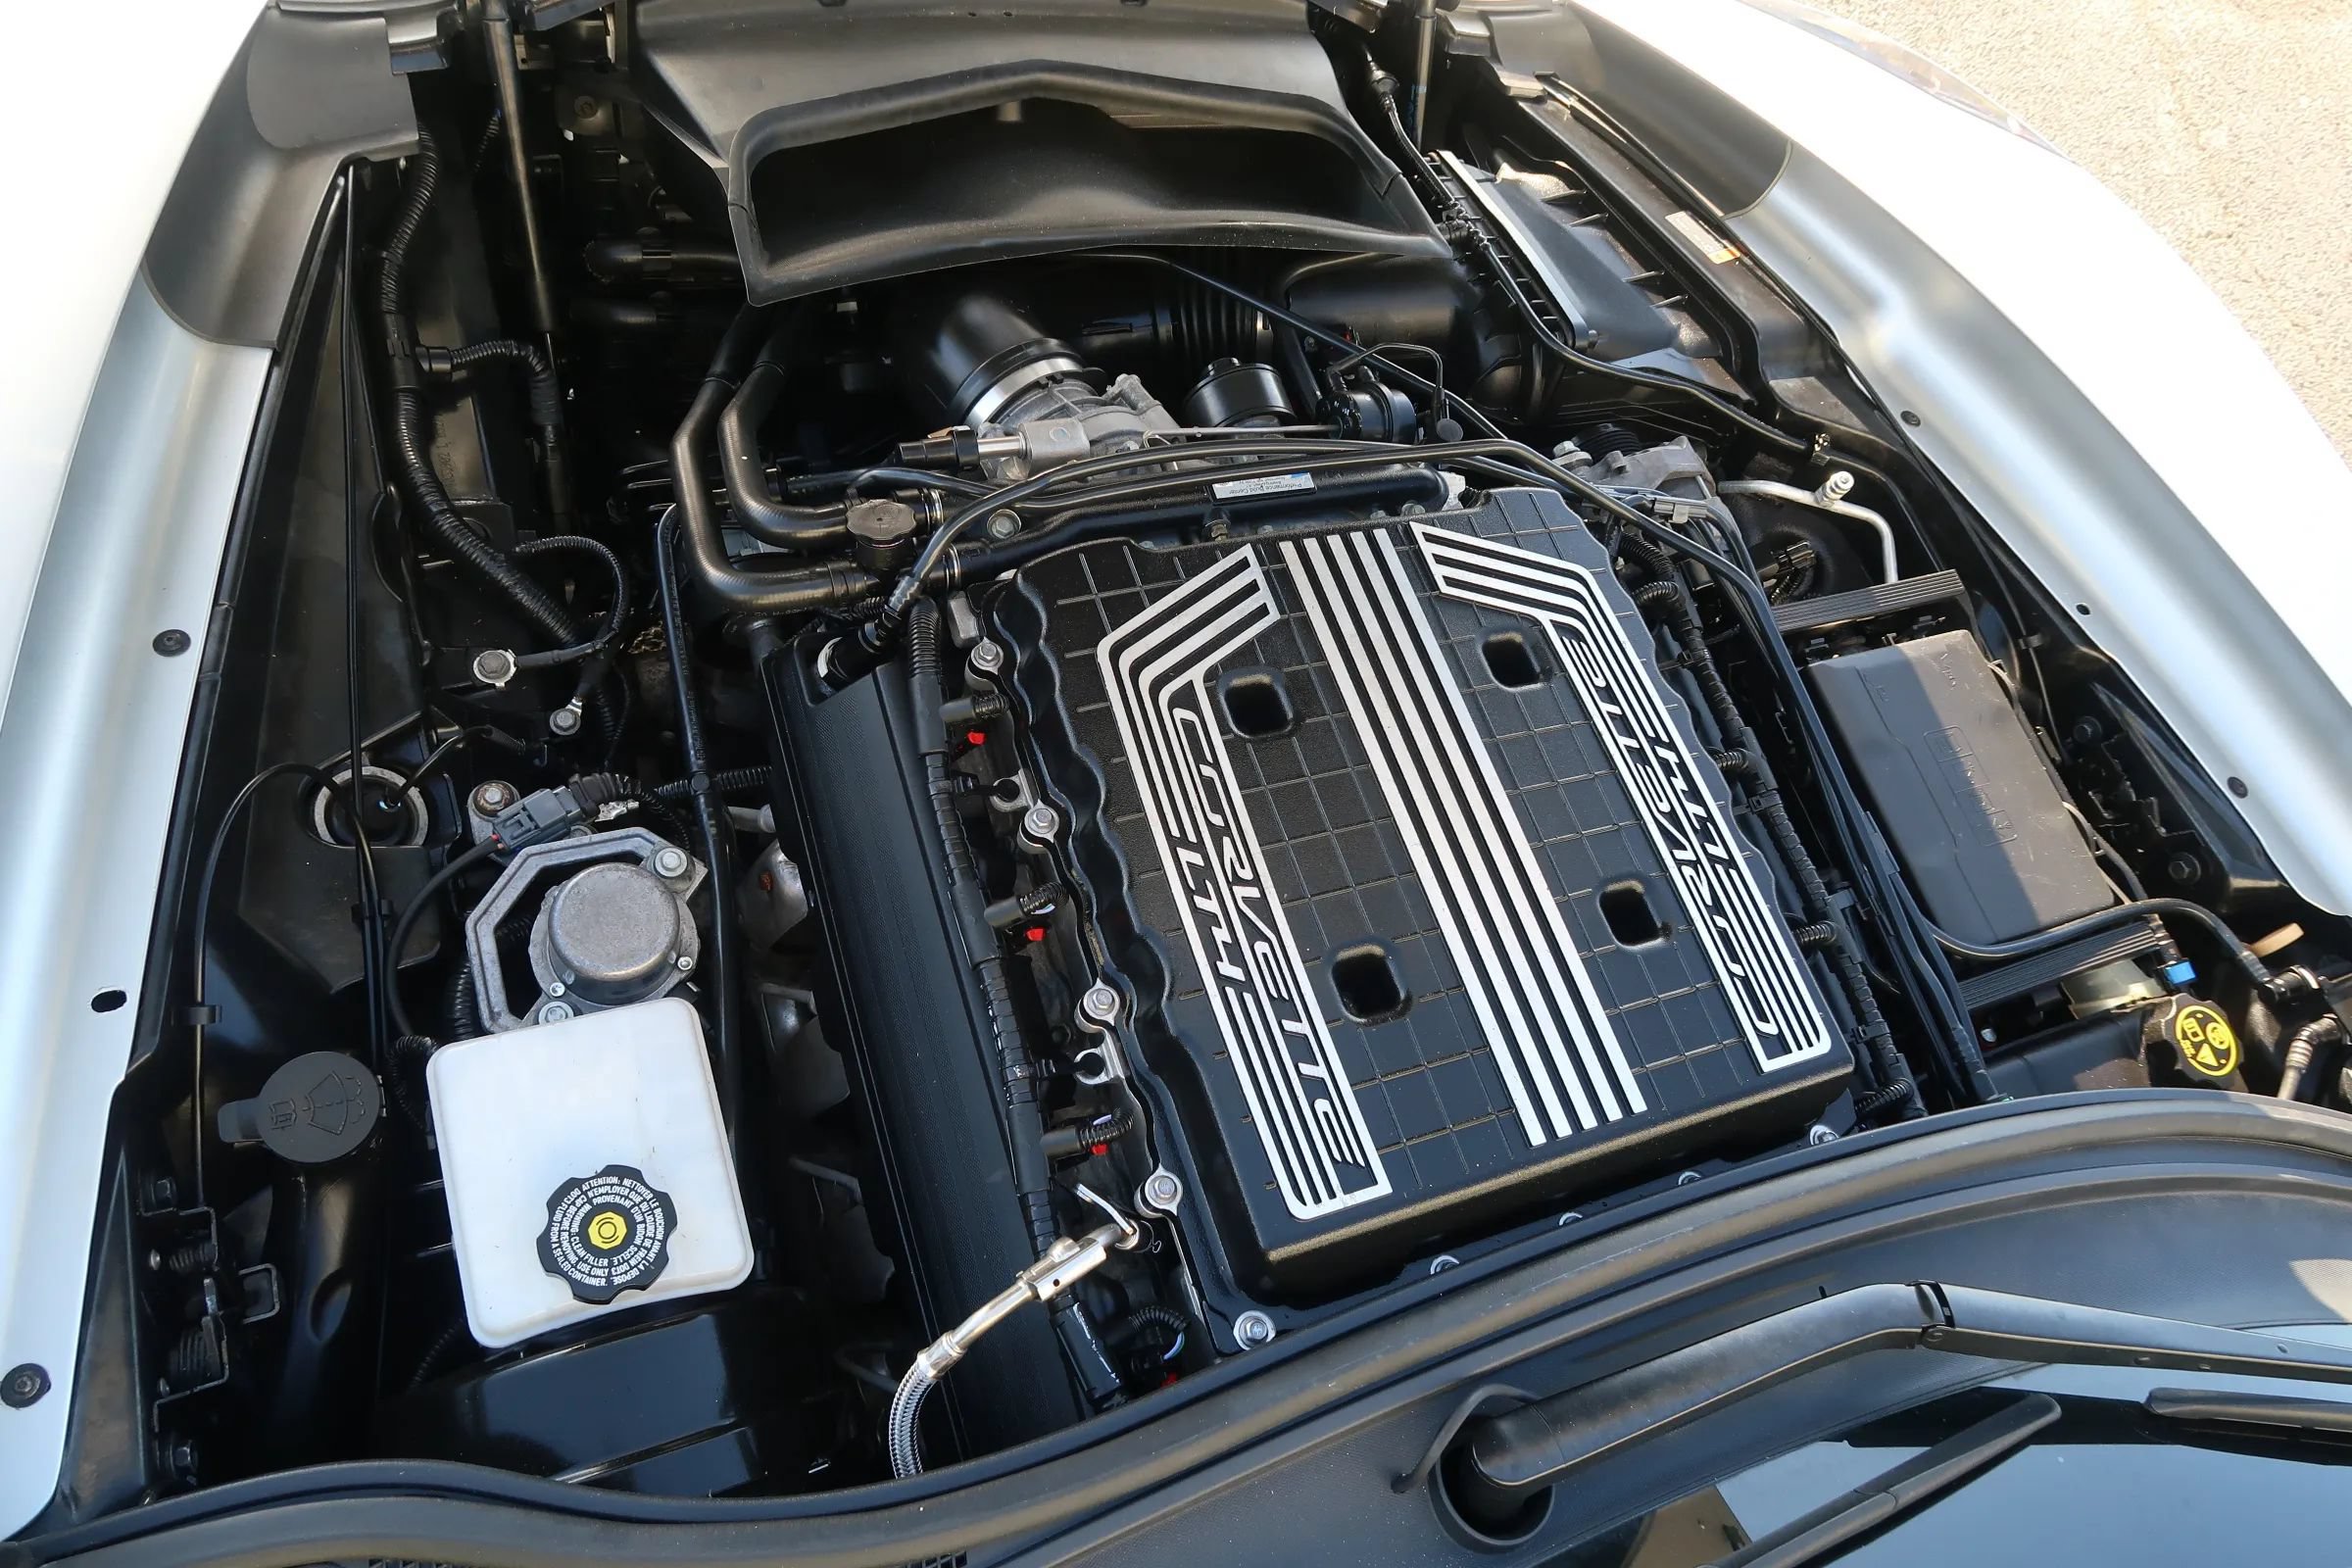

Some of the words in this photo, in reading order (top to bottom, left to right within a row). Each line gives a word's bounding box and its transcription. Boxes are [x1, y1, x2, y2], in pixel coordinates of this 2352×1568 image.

[1561, 635, 1779, 1036] CORVETTE
[1172, 706, 1365, 1170] CORVETTE
[581, 1176, 620, 1192] ATTENTION:
[587, 1185, 630, 1198] N'EMPLOYER
[622, 1177, 654, 1200] NETTOYER
[564, 1187, 582, 1205] DOT3
[574, 1194, 588, 1208] CAP
[592, 1194, 635, 1208] PROVENANT
[628, 1191, 644, 1204] QUE
[649, 1198, 660, 1208] LE
[553, 1202, 568, 1222] FLUID
[630, 1205, 645, 1223] D'UN
[639, 1200, 650, 1212] DU
[560, 1204, 578, 1231] BEFORE
[570, 1202, 593, 1235] WARNING:
[644, 1210, 656, 1238] LIQUIDE
[654, 1207, 665, 1240] BOUCHON
[550, 1222, 561, 1243] FROM
[633, 1223, 646, 1246] BIDON
[560, 1231, 579, 1266] REMOVING.
[570, 1236, 588, 1258] CLEAN
[642, 1238, 653, 1249] DE
[646, 1240, 662, 1262] AVANT
[553, 1249, 571, 1272] SEALED
[583, 1252, 609, 1267] FILLER
[610, 1245, 638, 1266] SCELLE.
[628, 1247, 648, 1266] FREIN
[637, 1259, 649, 1270] LA
[576, 1260, 592, 1274] USE
[590, 1267, 610, 1277] ONLY
[610, 1267, 640, 1286] DEPOSE.
[611, 1261, 630, 1275] DOT3
[568, 1268, 608, 1286] CONTAINER.
